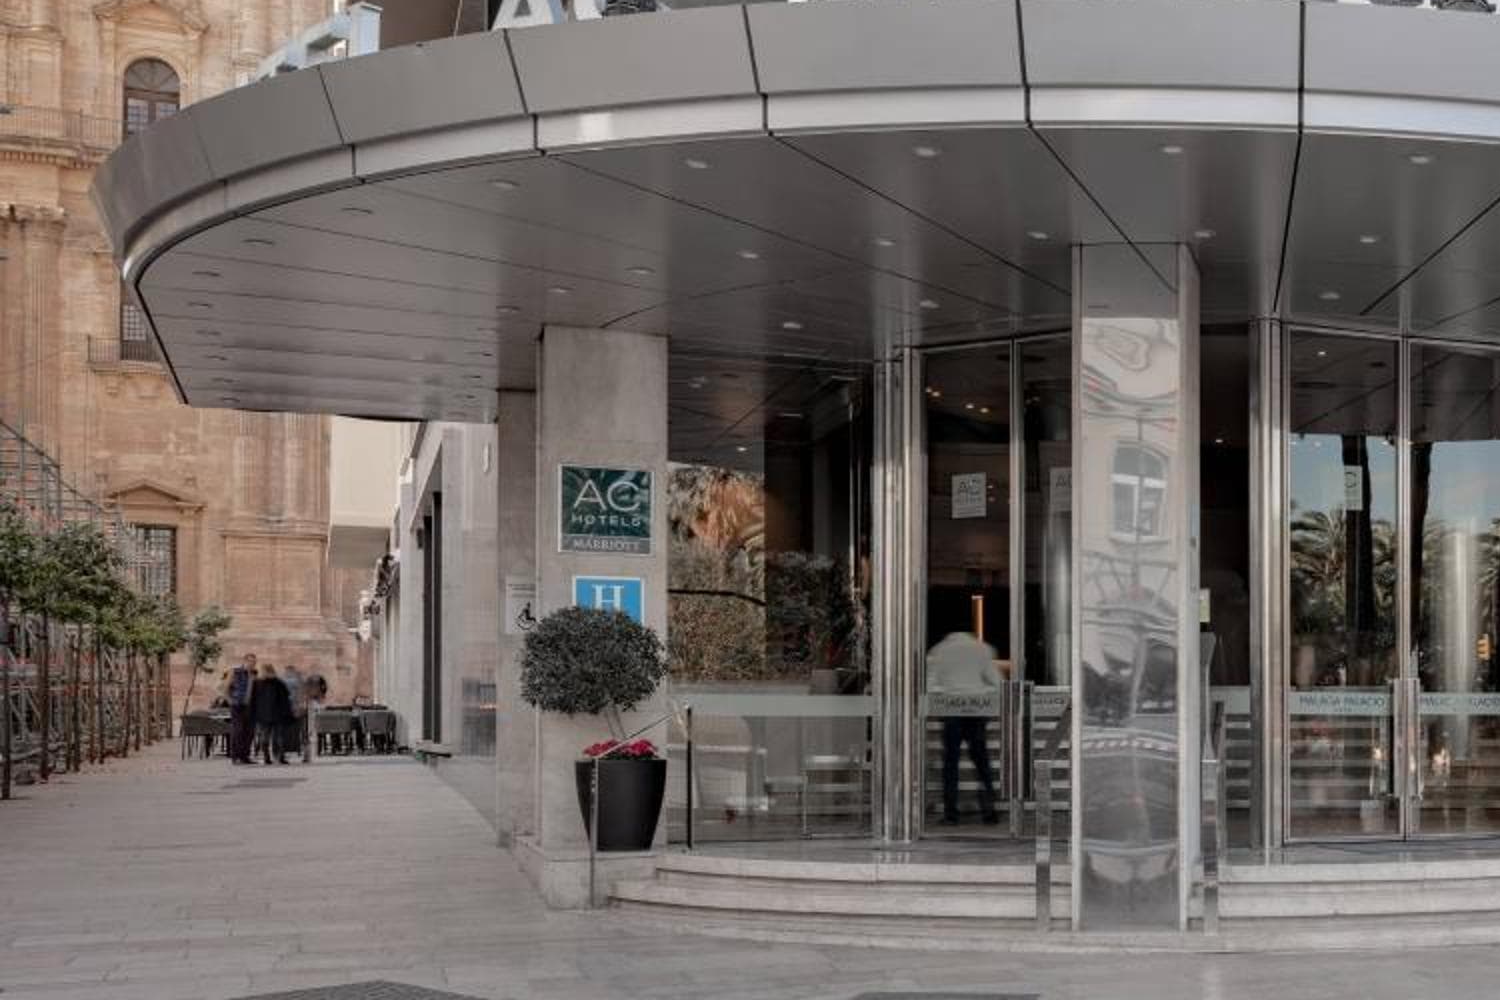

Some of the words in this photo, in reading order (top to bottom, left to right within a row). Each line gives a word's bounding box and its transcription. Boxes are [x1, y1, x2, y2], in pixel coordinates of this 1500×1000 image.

[573, 479, 641, 512] AC
[570, 513, 642, 527] HOTELS
[591, 583, 625, 611] H
